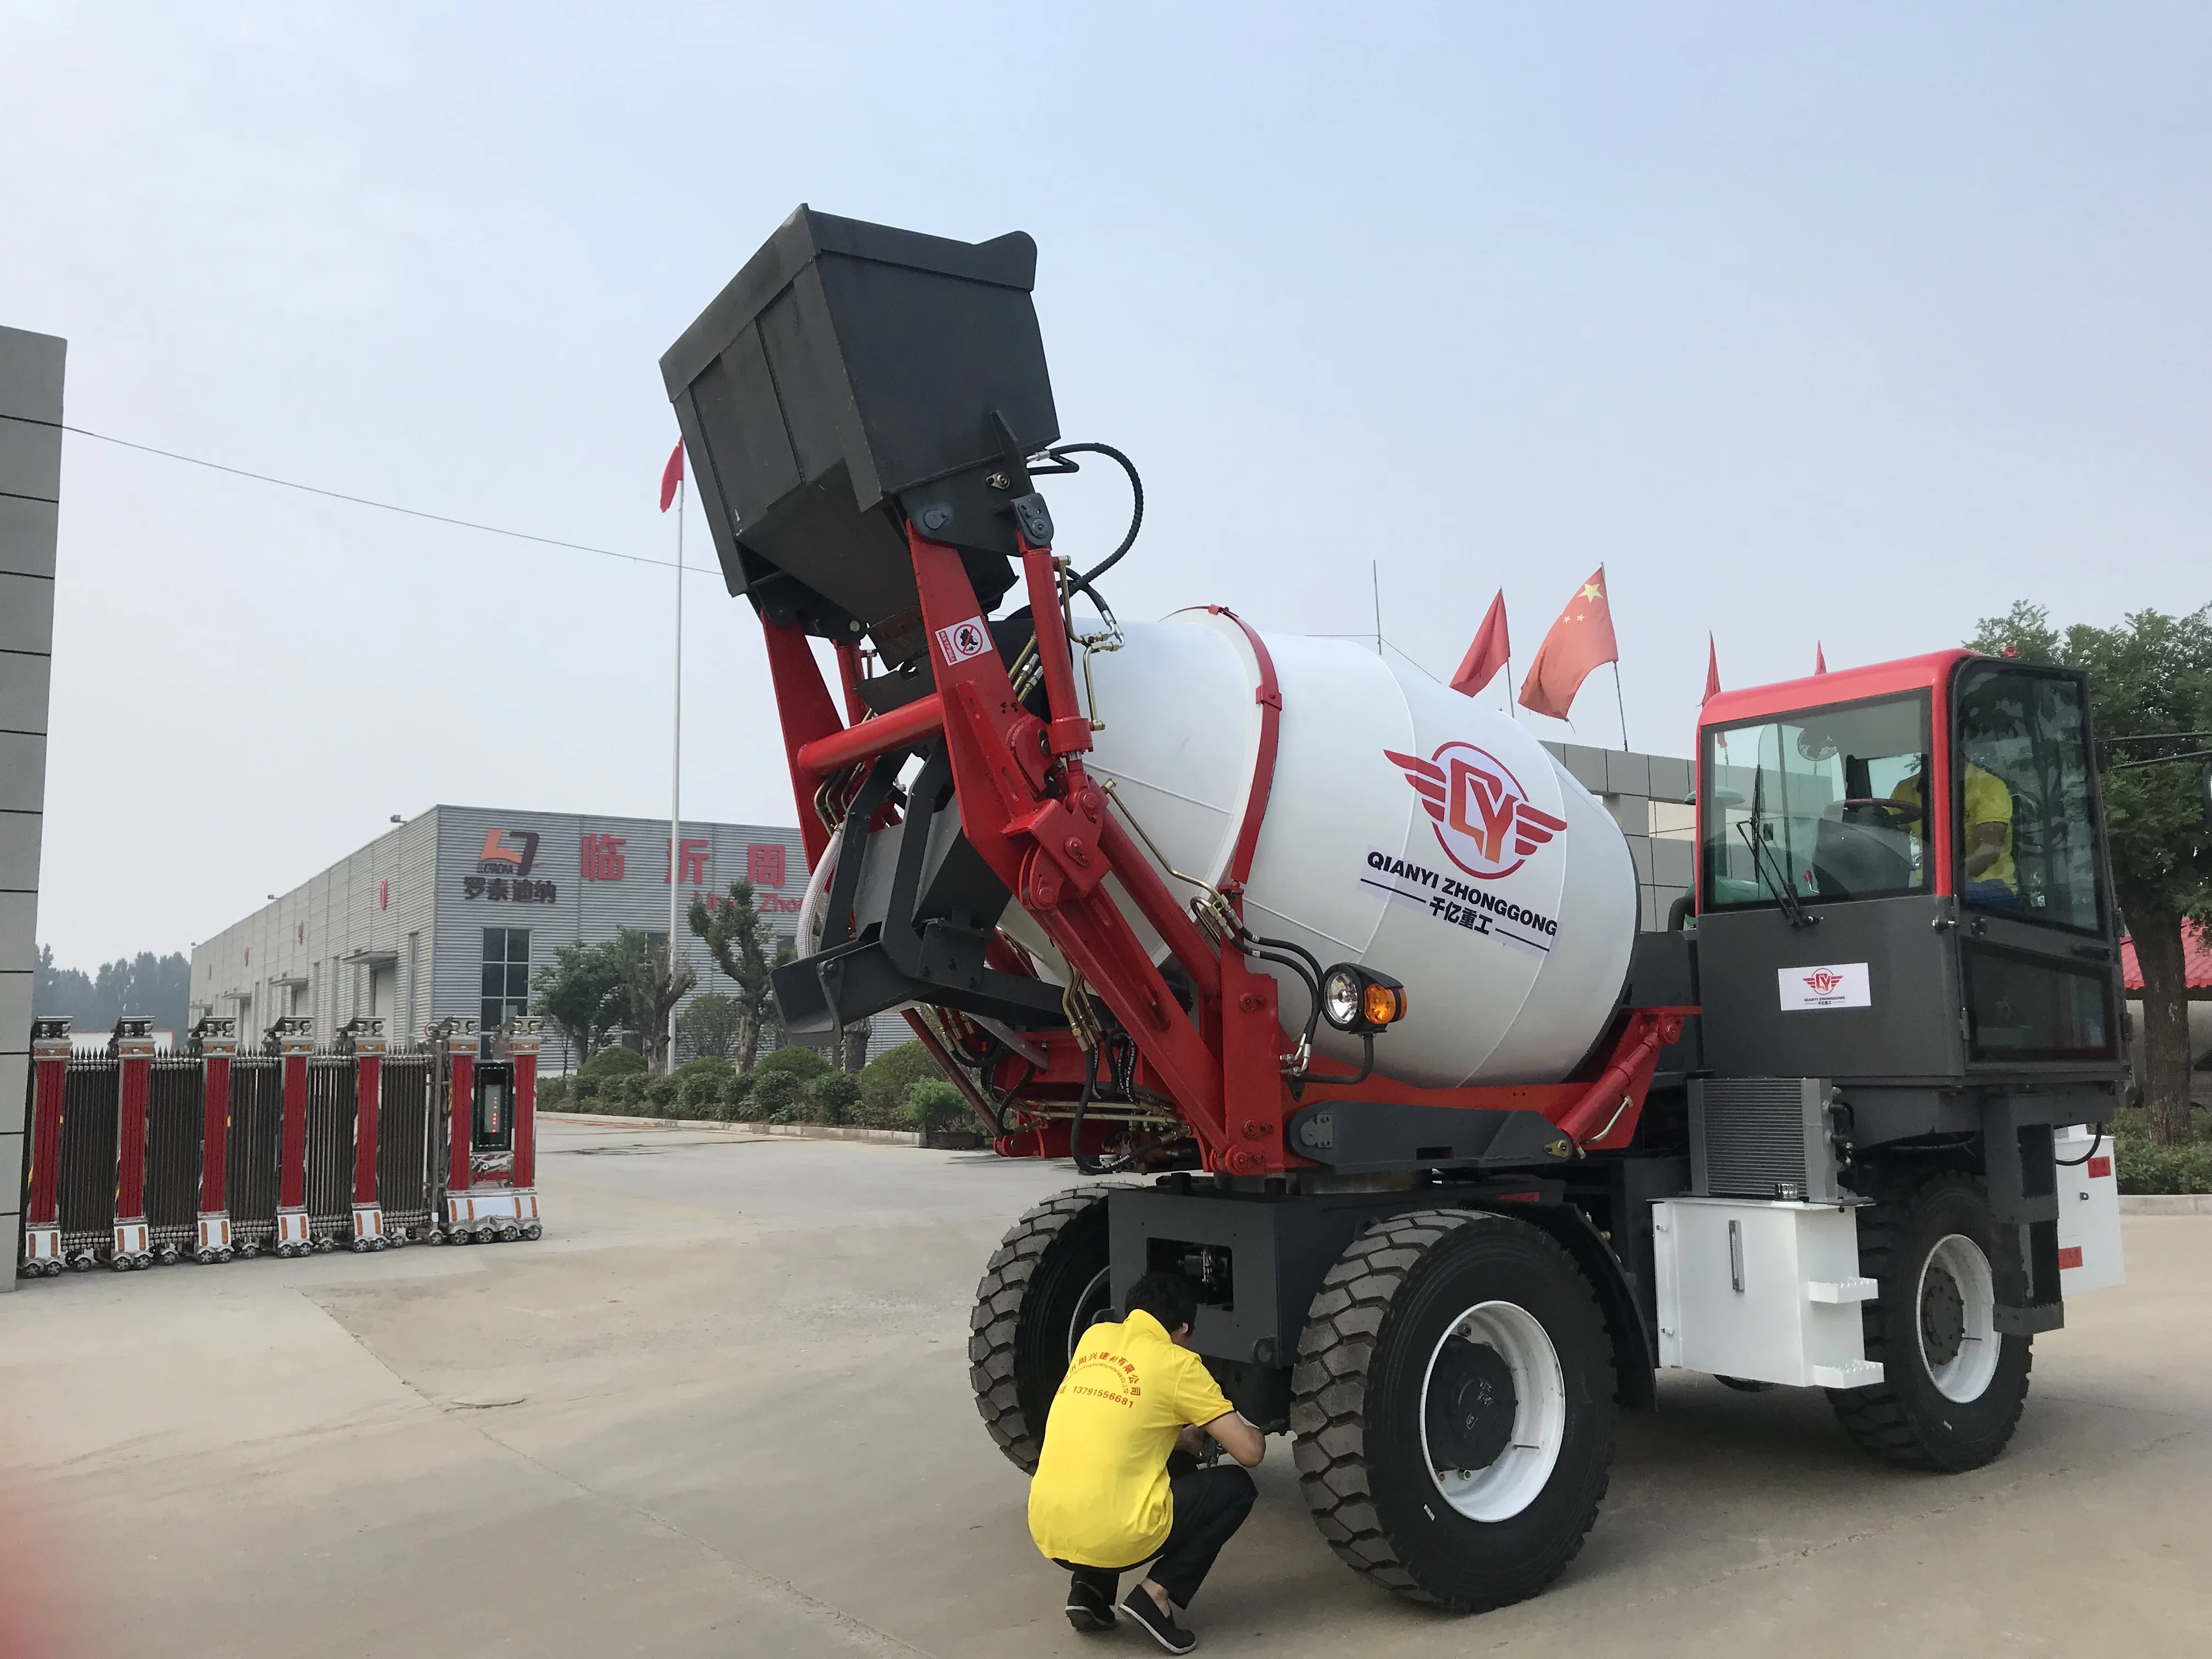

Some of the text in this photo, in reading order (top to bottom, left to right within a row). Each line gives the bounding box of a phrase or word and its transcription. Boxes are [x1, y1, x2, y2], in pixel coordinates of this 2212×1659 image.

[1367, 851, 1558, 936] QIANYI ZHONGGONG
[1429, 896, 1493, 935] 千亿重工
[1062, 1351, 1141, 1396] 沂周兴建材有限公司
[1073, 1386, 1134, 1408] 13791556681
